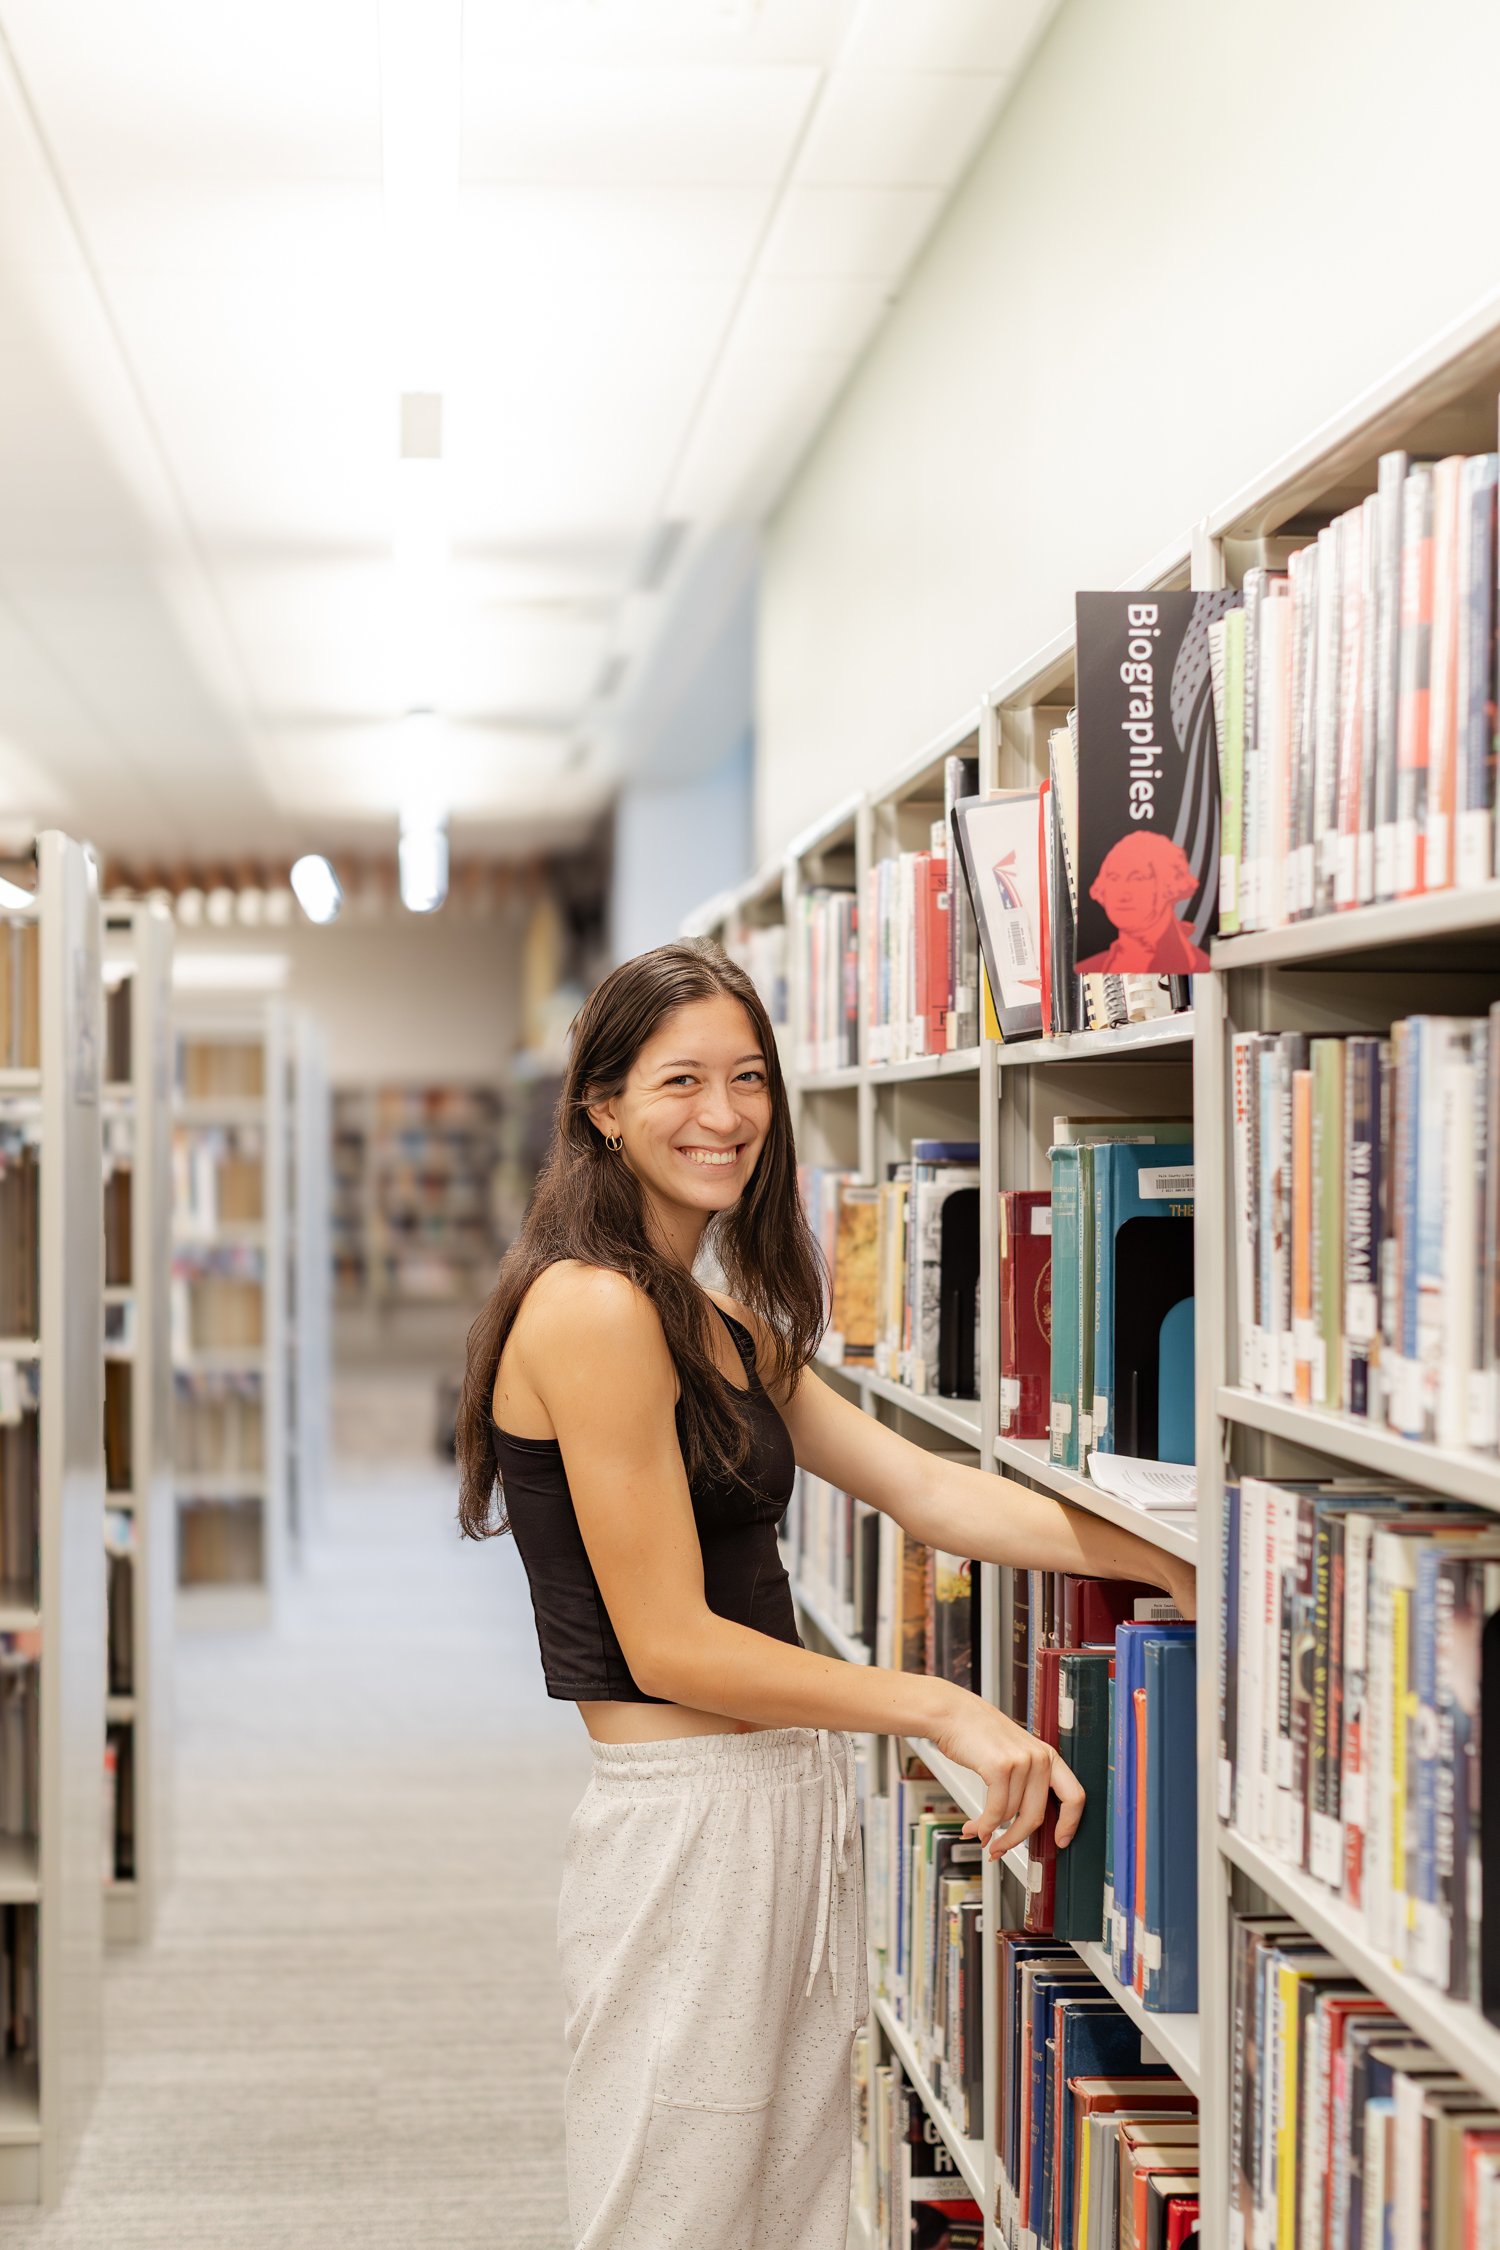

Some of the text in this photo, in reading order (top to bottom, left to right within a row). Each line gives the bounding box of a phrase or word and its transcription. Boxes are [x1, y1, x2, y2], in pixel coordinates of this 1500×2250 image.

[1120, 603, 1160, 820] Biographies
[1235, 1045, 1246, 1123] Book
[1168, 1204, 1194, 1217] THE
[1346, 1141, 1372, 1283] NO ORDINAR
[1264, 1500, 1277, 1626] ALL TOO HUMAN
[1280, 1628, 1291, 1656] THE
[1279, 1659, 1291, 1728] KENNEDY
[1436, 1714, 1455, 1762] THE
[1434, 1767, 1455, 1876] COLONEL
[1231, 2006, 1244, 2210] MORGENTHAU
